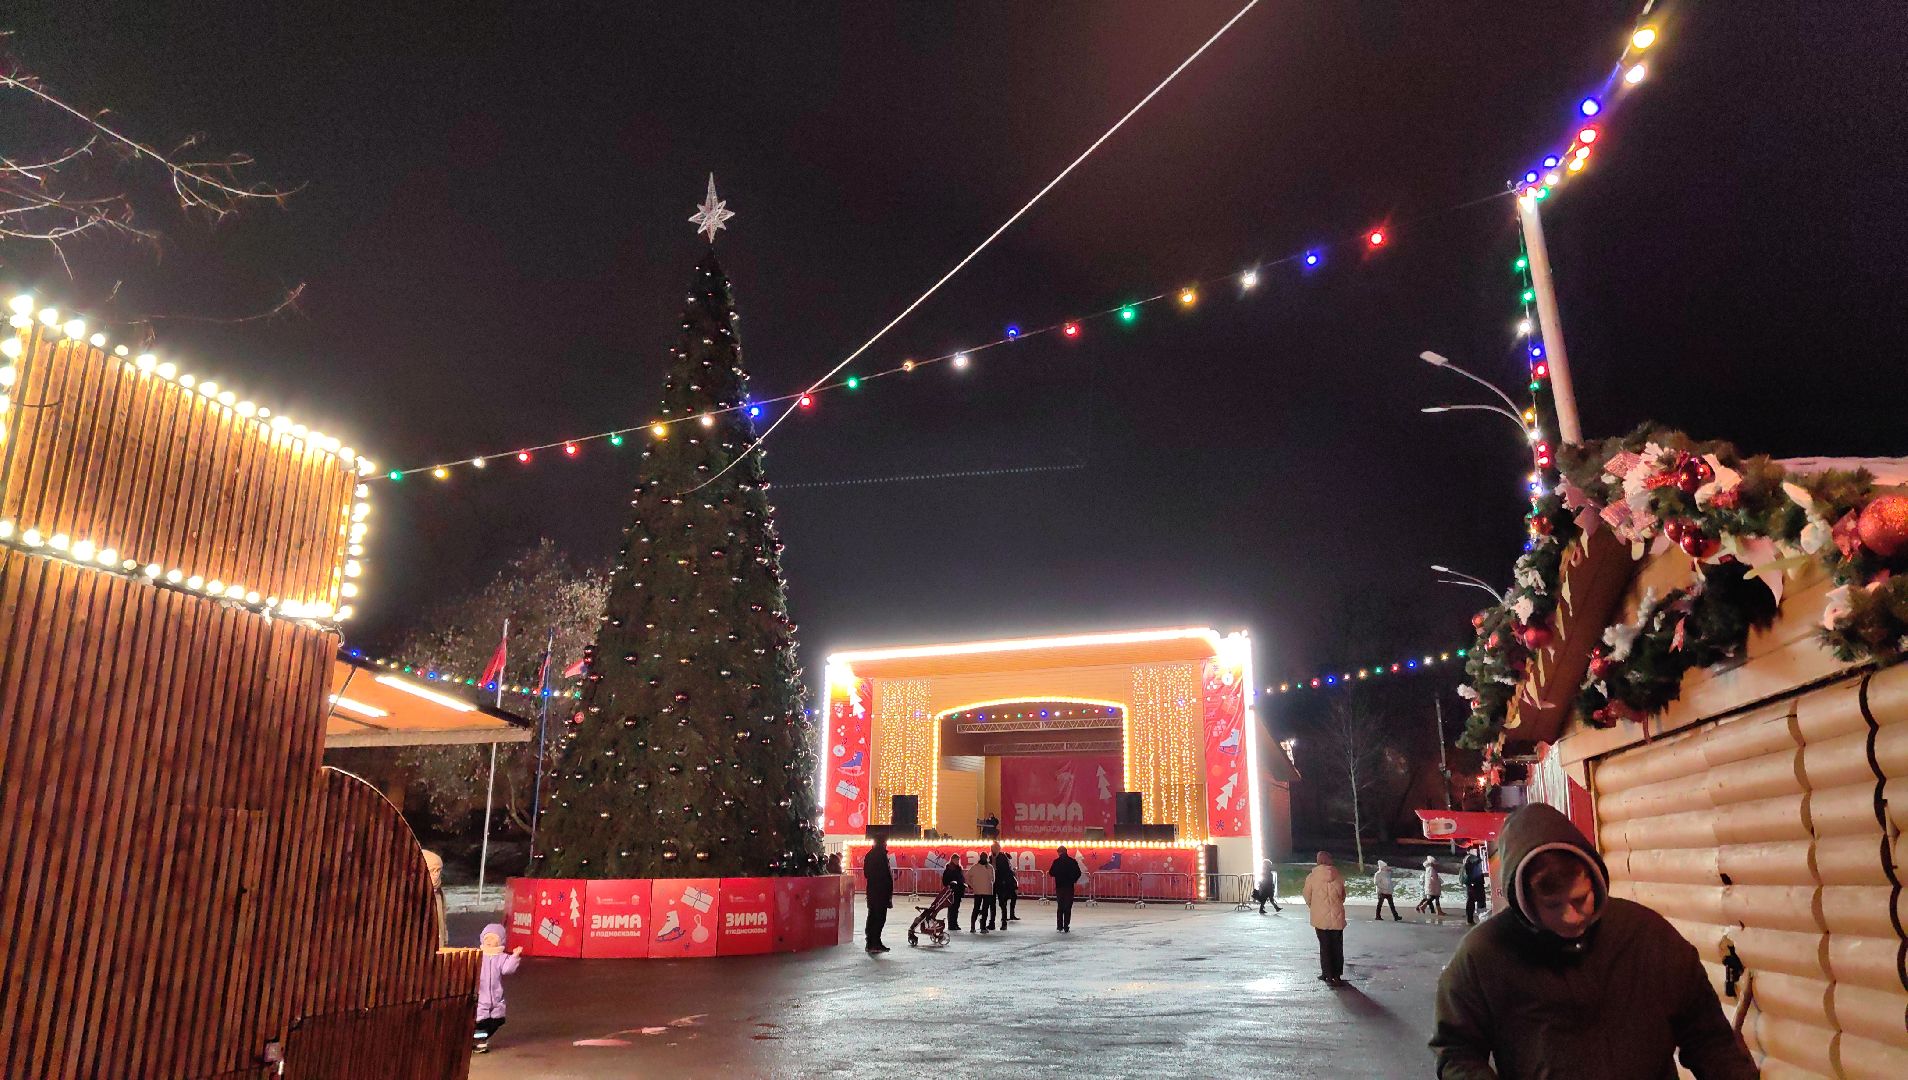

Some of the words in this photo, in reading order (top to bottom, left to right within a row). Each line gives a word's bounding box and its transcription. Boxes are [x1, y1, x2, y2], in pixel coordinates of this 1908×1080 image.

[1014, 802, 1083, 821] ЗИМА
[590, 914, 641, 929] ЗИМА
[725, 912, 768, 927] ЗИМА
